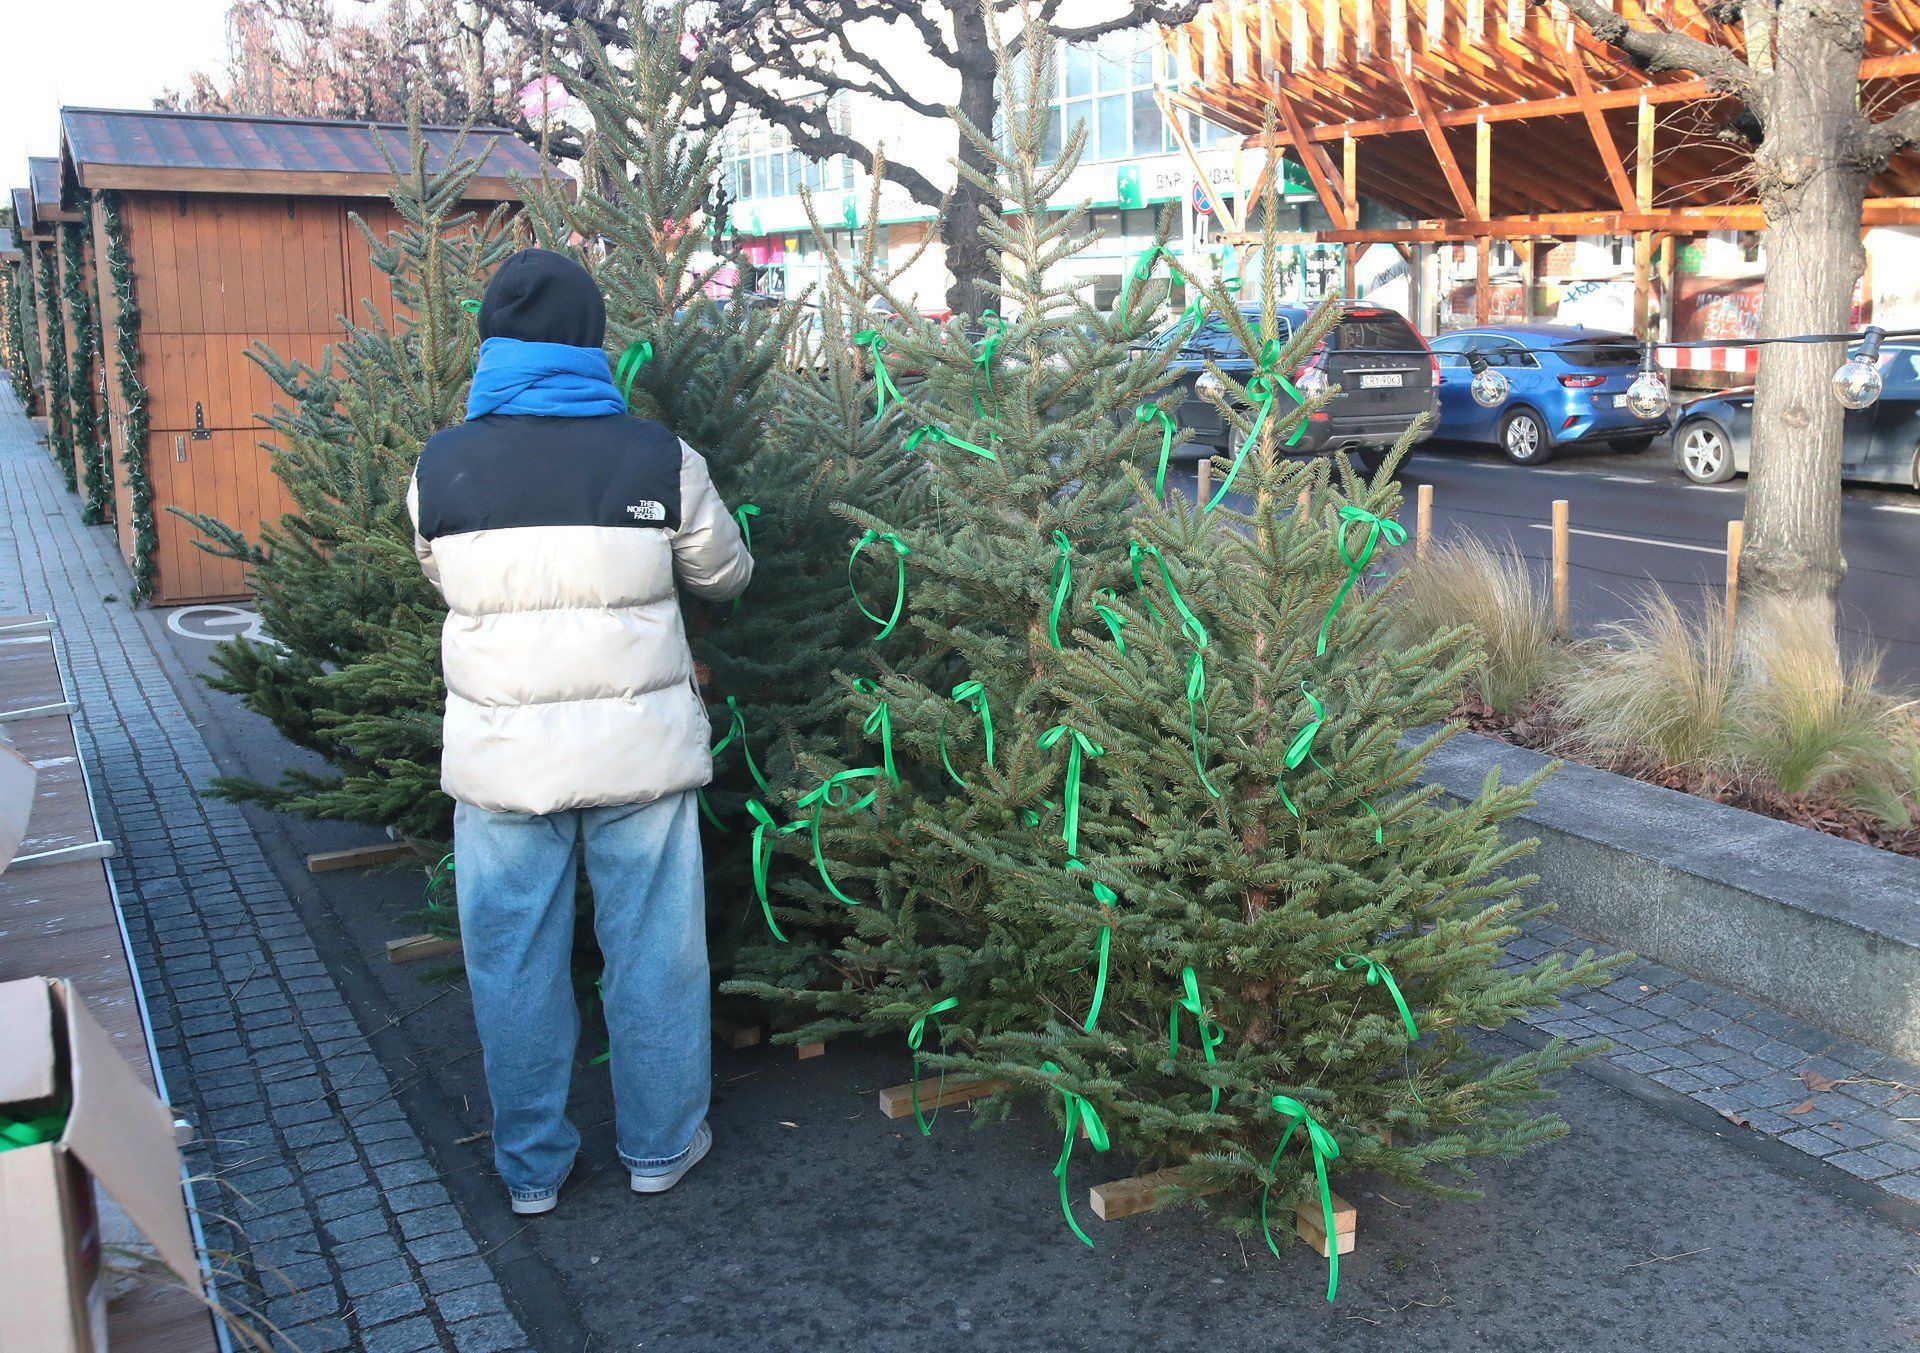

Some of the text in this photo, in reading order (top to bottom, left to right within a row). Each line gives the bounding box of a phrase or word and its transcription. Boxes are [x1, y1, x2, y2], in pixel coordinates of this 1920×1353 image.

[1156, 172, 1181, 190] BNP
[639, 499, 655, 507] THE
[626, 505, 654, 513] NORTH
[633, 512, 655, 520] FACE
